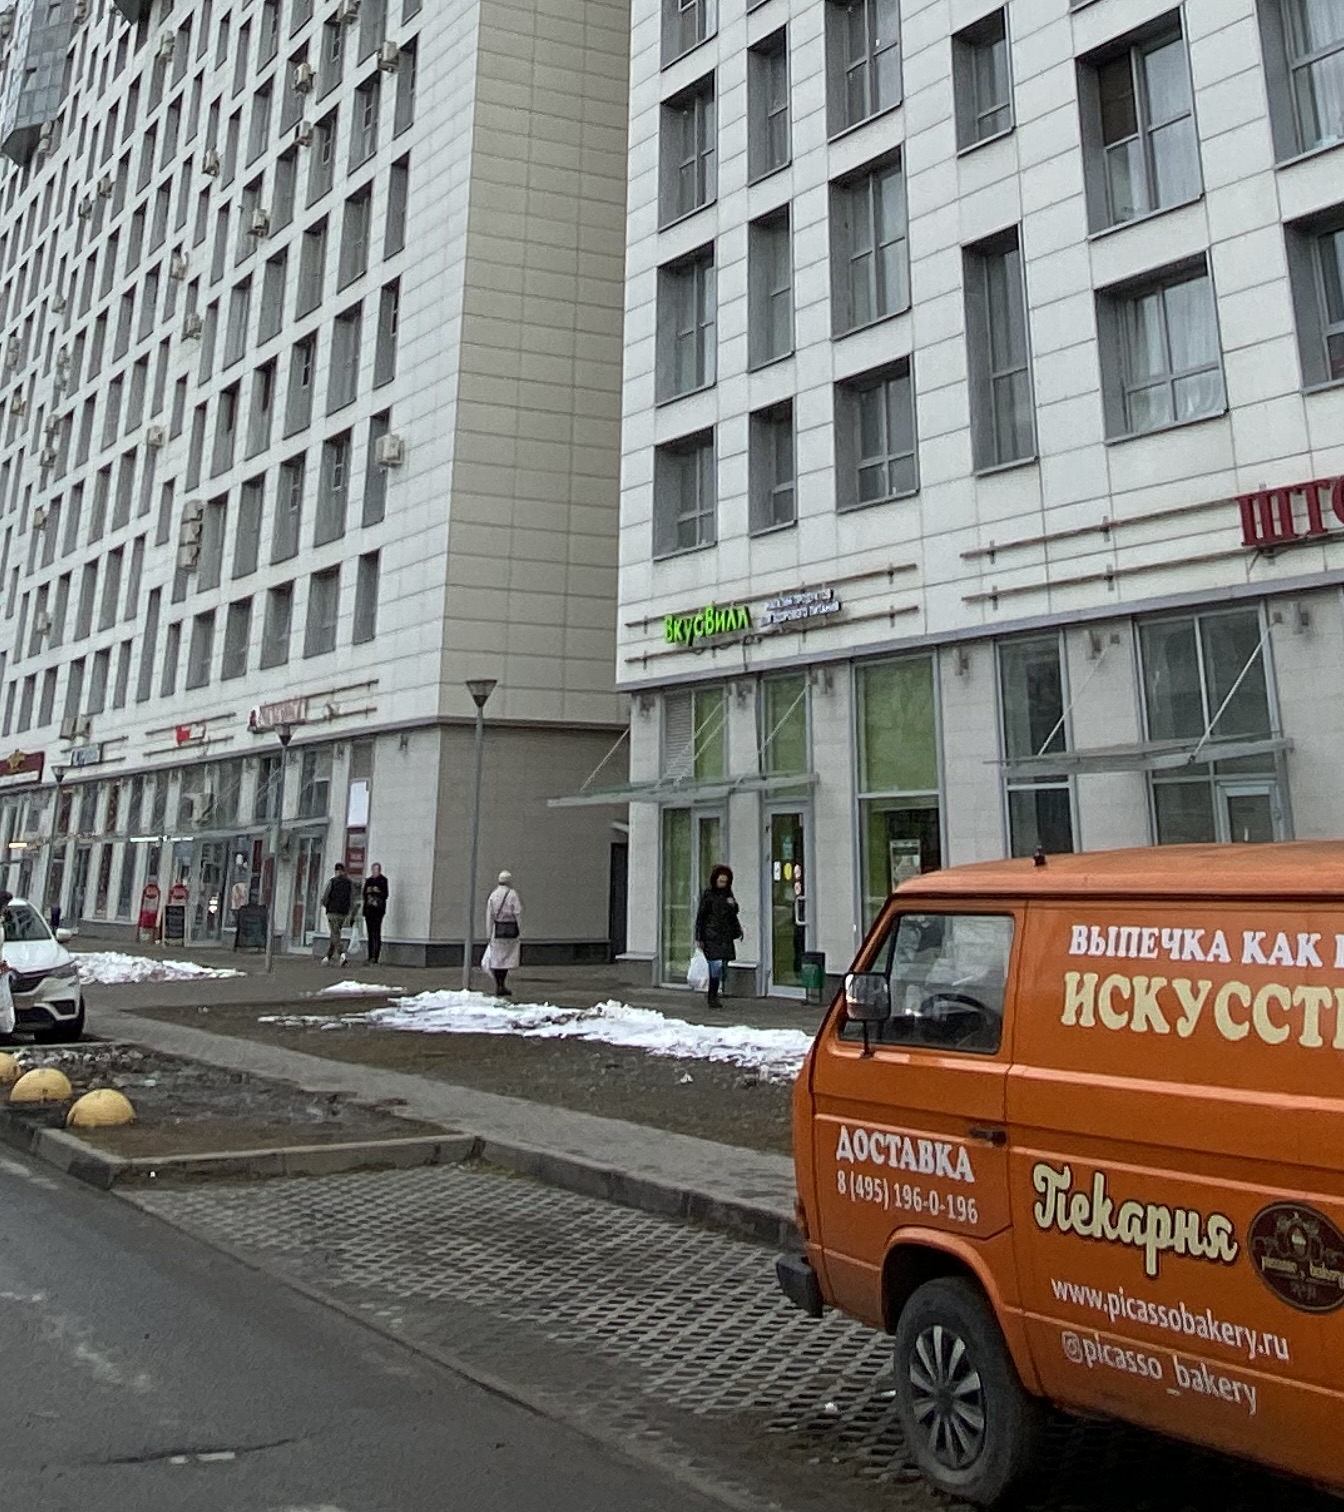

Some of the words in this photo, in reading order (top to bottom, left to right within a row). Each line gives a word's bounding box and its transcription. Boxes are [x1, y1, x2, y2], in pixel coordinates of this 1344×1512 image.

[1069, 925, 1232, 963] ВЫПЕЧКА
[1241, 931, 1323, 968] КАК
[836, 1125, 975, 1183] ДОСТАВКА
[837, 1169, 847, 1195] 8
[850, 1170, 889, 1211] (495)
[893, 1182, 978, 1225] 196-0-196
[1032, 1162, 1238, 1276] Пекарня
[1050, 1278, 1290, 1361] www.picassobakery.ru
